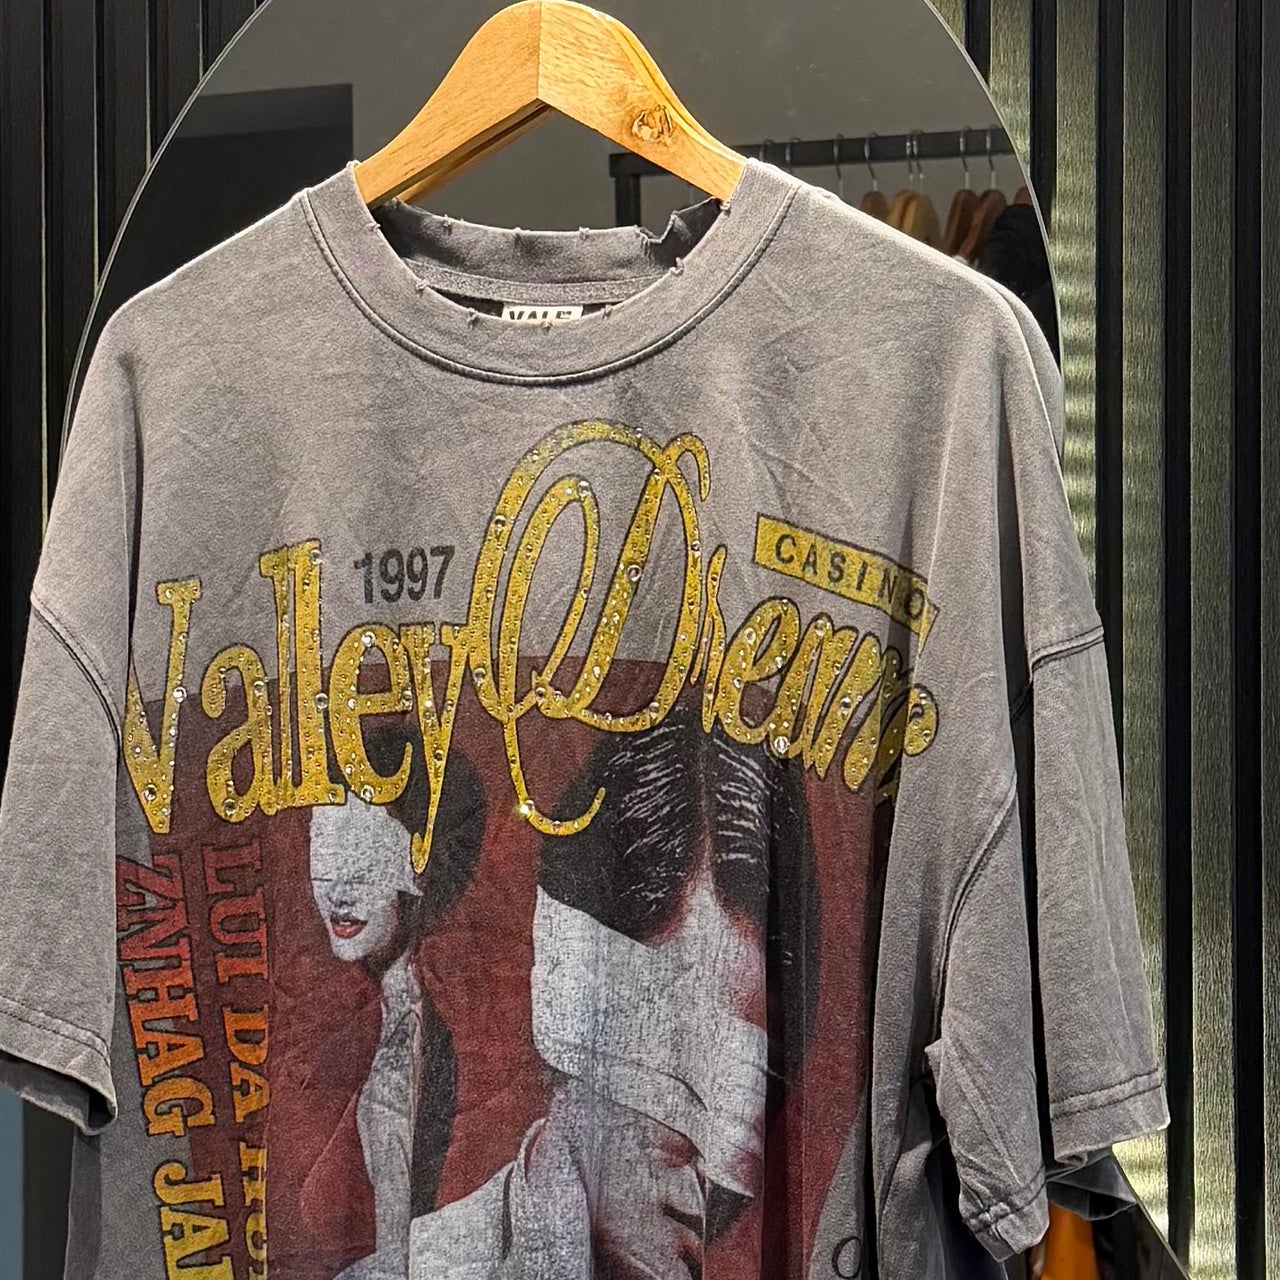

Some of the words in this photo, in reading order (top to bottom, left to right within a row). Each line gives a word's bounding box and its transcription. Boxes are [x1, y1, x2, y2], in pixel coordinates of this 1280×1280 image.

[353, 546, 455, 604] 1997
[774, 533, 926, 620] CASINO
[121, 538, 472, 875] Valley
[203, 842, 269, 983] LUI
[223, 1004, 271, 1124] DA
